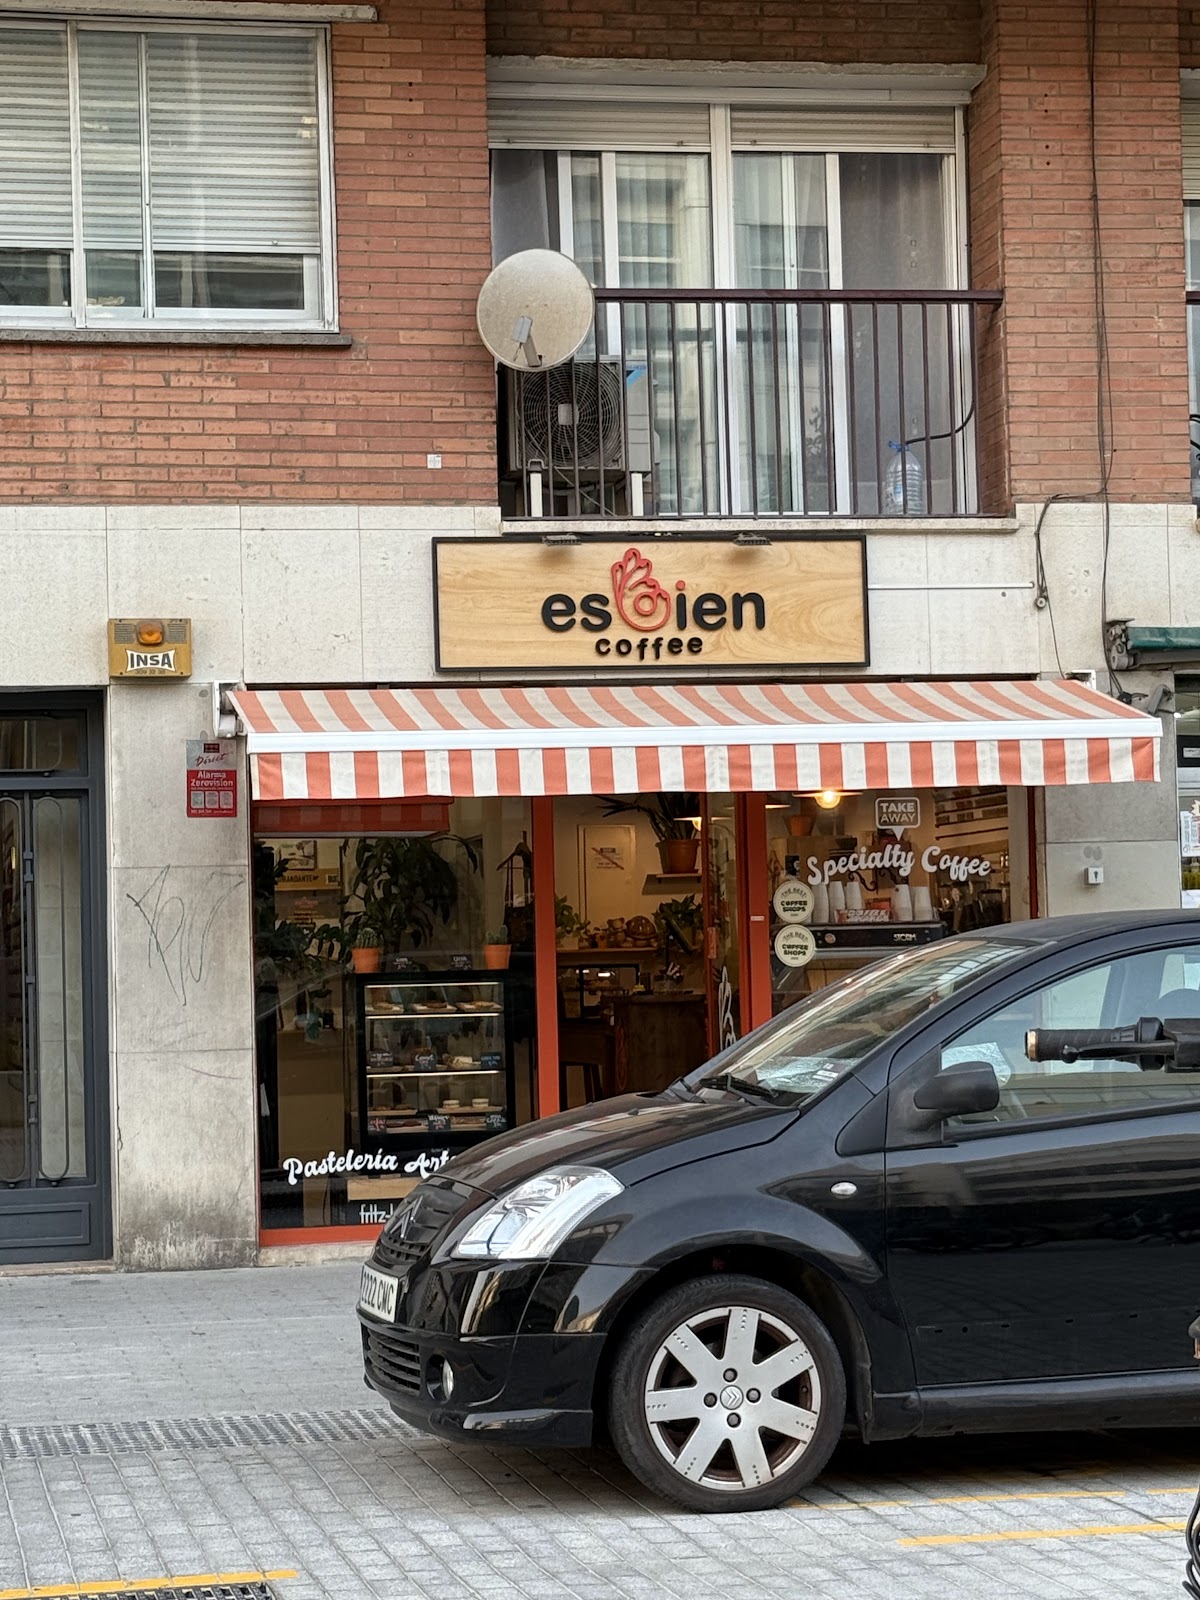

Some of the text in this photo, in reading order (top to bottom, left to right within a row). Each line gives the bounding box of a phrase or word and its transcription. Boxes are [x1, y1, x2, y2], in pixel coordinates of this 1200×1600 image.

[595, 636, 703, 660] coffee
[130, 652, 172, 669] INSA
[195, 752, 228, 768] Direct
[197, 770, 227, 779] Alarma
[880, 802, 915, 813] TAKE
[880, 812, 916, 823] AWAY
[807, 843, 992, 885] Specialty Coffee
[781, 887, 807, 898] THE BEST
[783, 931, 808, 943] THE BEST
[893, 933, 917, 942] STORM
[781, 943, 809, 951] COFFEE
[283, 1148, 457, 1186] Pastelería Art
